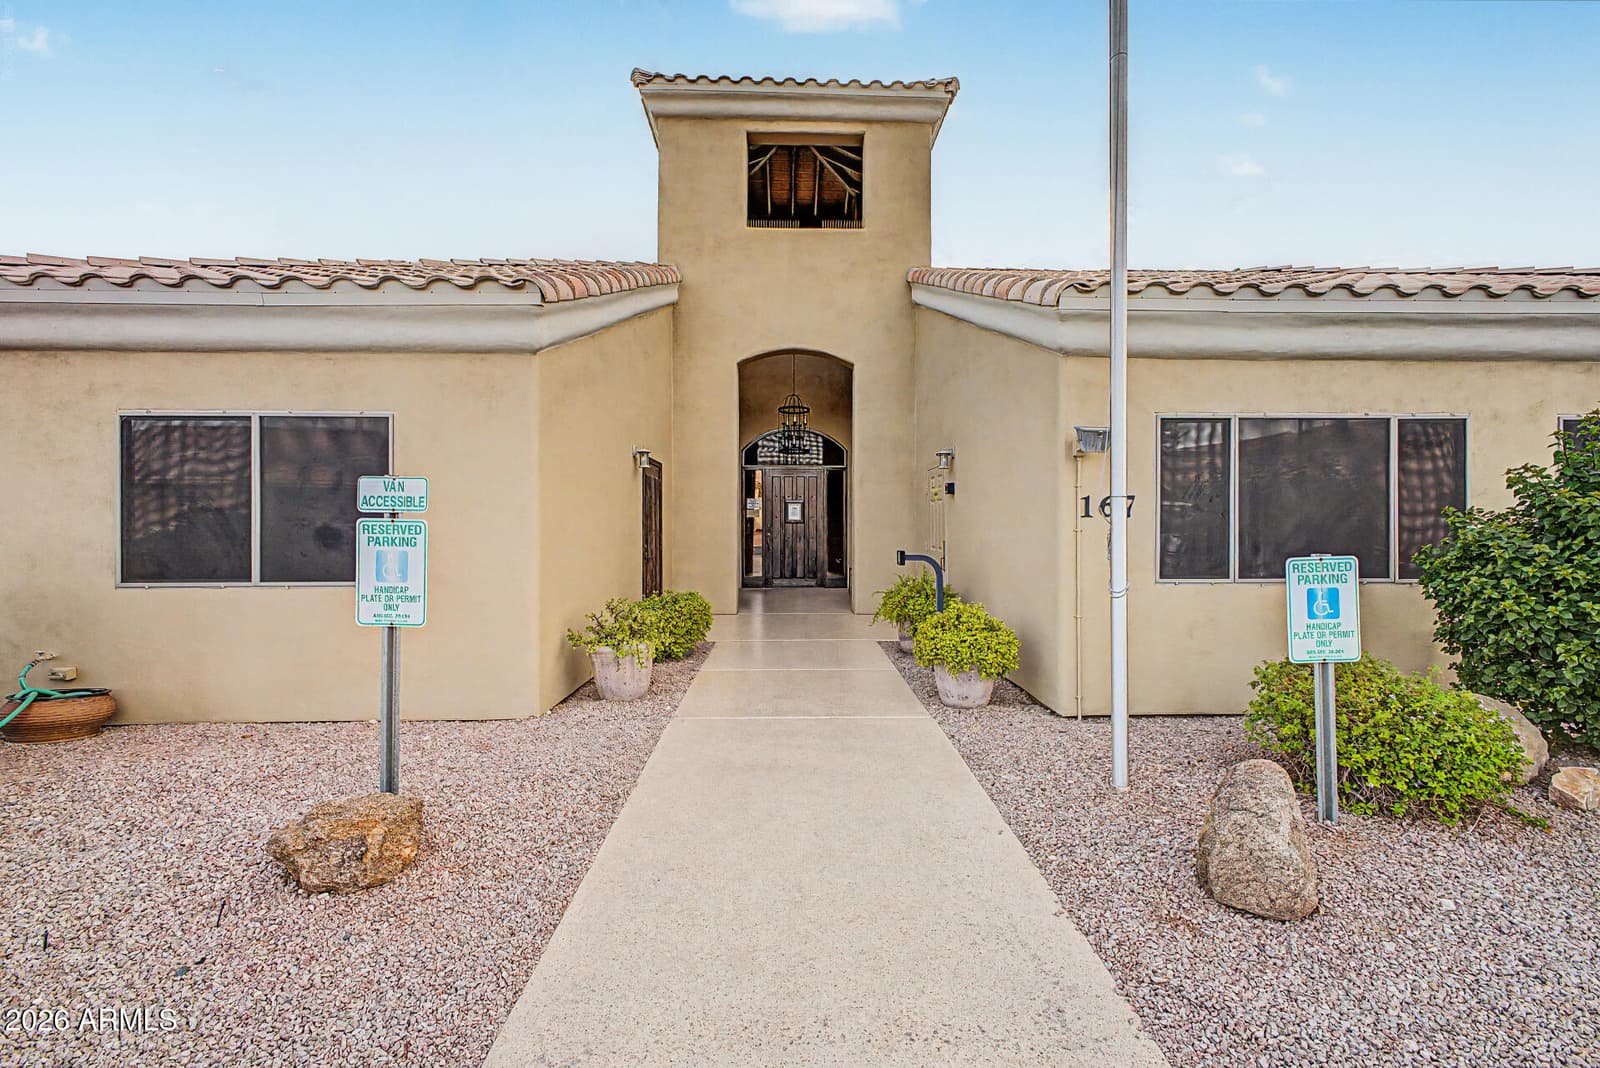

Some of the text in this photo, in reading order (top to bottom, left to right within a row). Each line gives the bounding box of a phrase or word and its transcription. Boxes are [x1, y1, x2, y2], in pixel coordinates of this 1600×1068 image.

[383, 480, 405, 492] VAN
[361, 495, 425, 508] ACCESSIBLE
[362, 524, 422, 536] RESERVED
[367, 536, 417, 548] PARKING
[1292, 561, 1353, 574] RESERVED
[1297, 573, 1349, 585] PARKING
[374, 585, 409, 594] HANDICAP
[361, 594, 422, 603] PLATE OR PERMIT
[383, 603, 400, 611] ONLY
[1306, 622, 1342, 631] HANDICAP
[1293, 630, 1355, 640] PLATE OR PERMIT
[1315, 639, 1333, 648] ONLY
